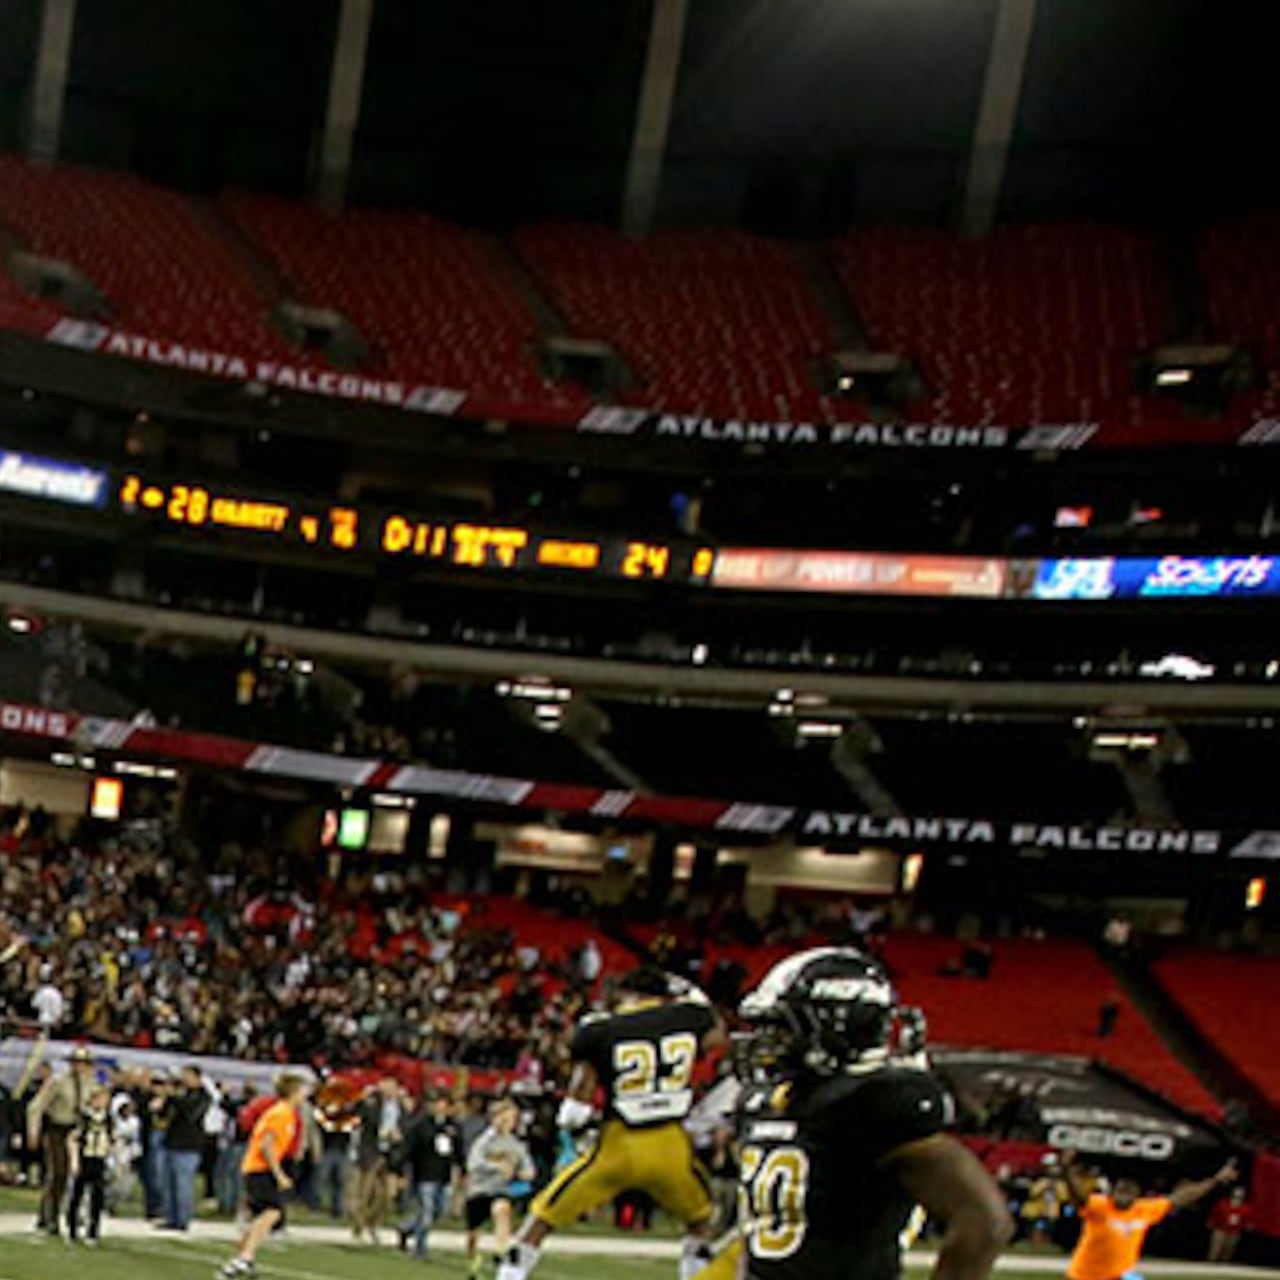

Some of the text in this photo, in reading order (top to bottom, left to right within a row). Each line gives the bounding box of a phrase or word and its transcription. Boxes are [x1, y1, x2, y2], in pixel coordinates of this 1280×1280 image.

[108, 332, 405, 404] ATLANTA FALCONS
[657, 415, 1009, 447] ATLANTA FALCONS
[621, 542, 669, 579] 24
[803, 812, 1221, 854] ATLANTA FALCONS
[612, 1031, 698, 1096] 23
[1046, 1122, 1176, 1160] GEICO
